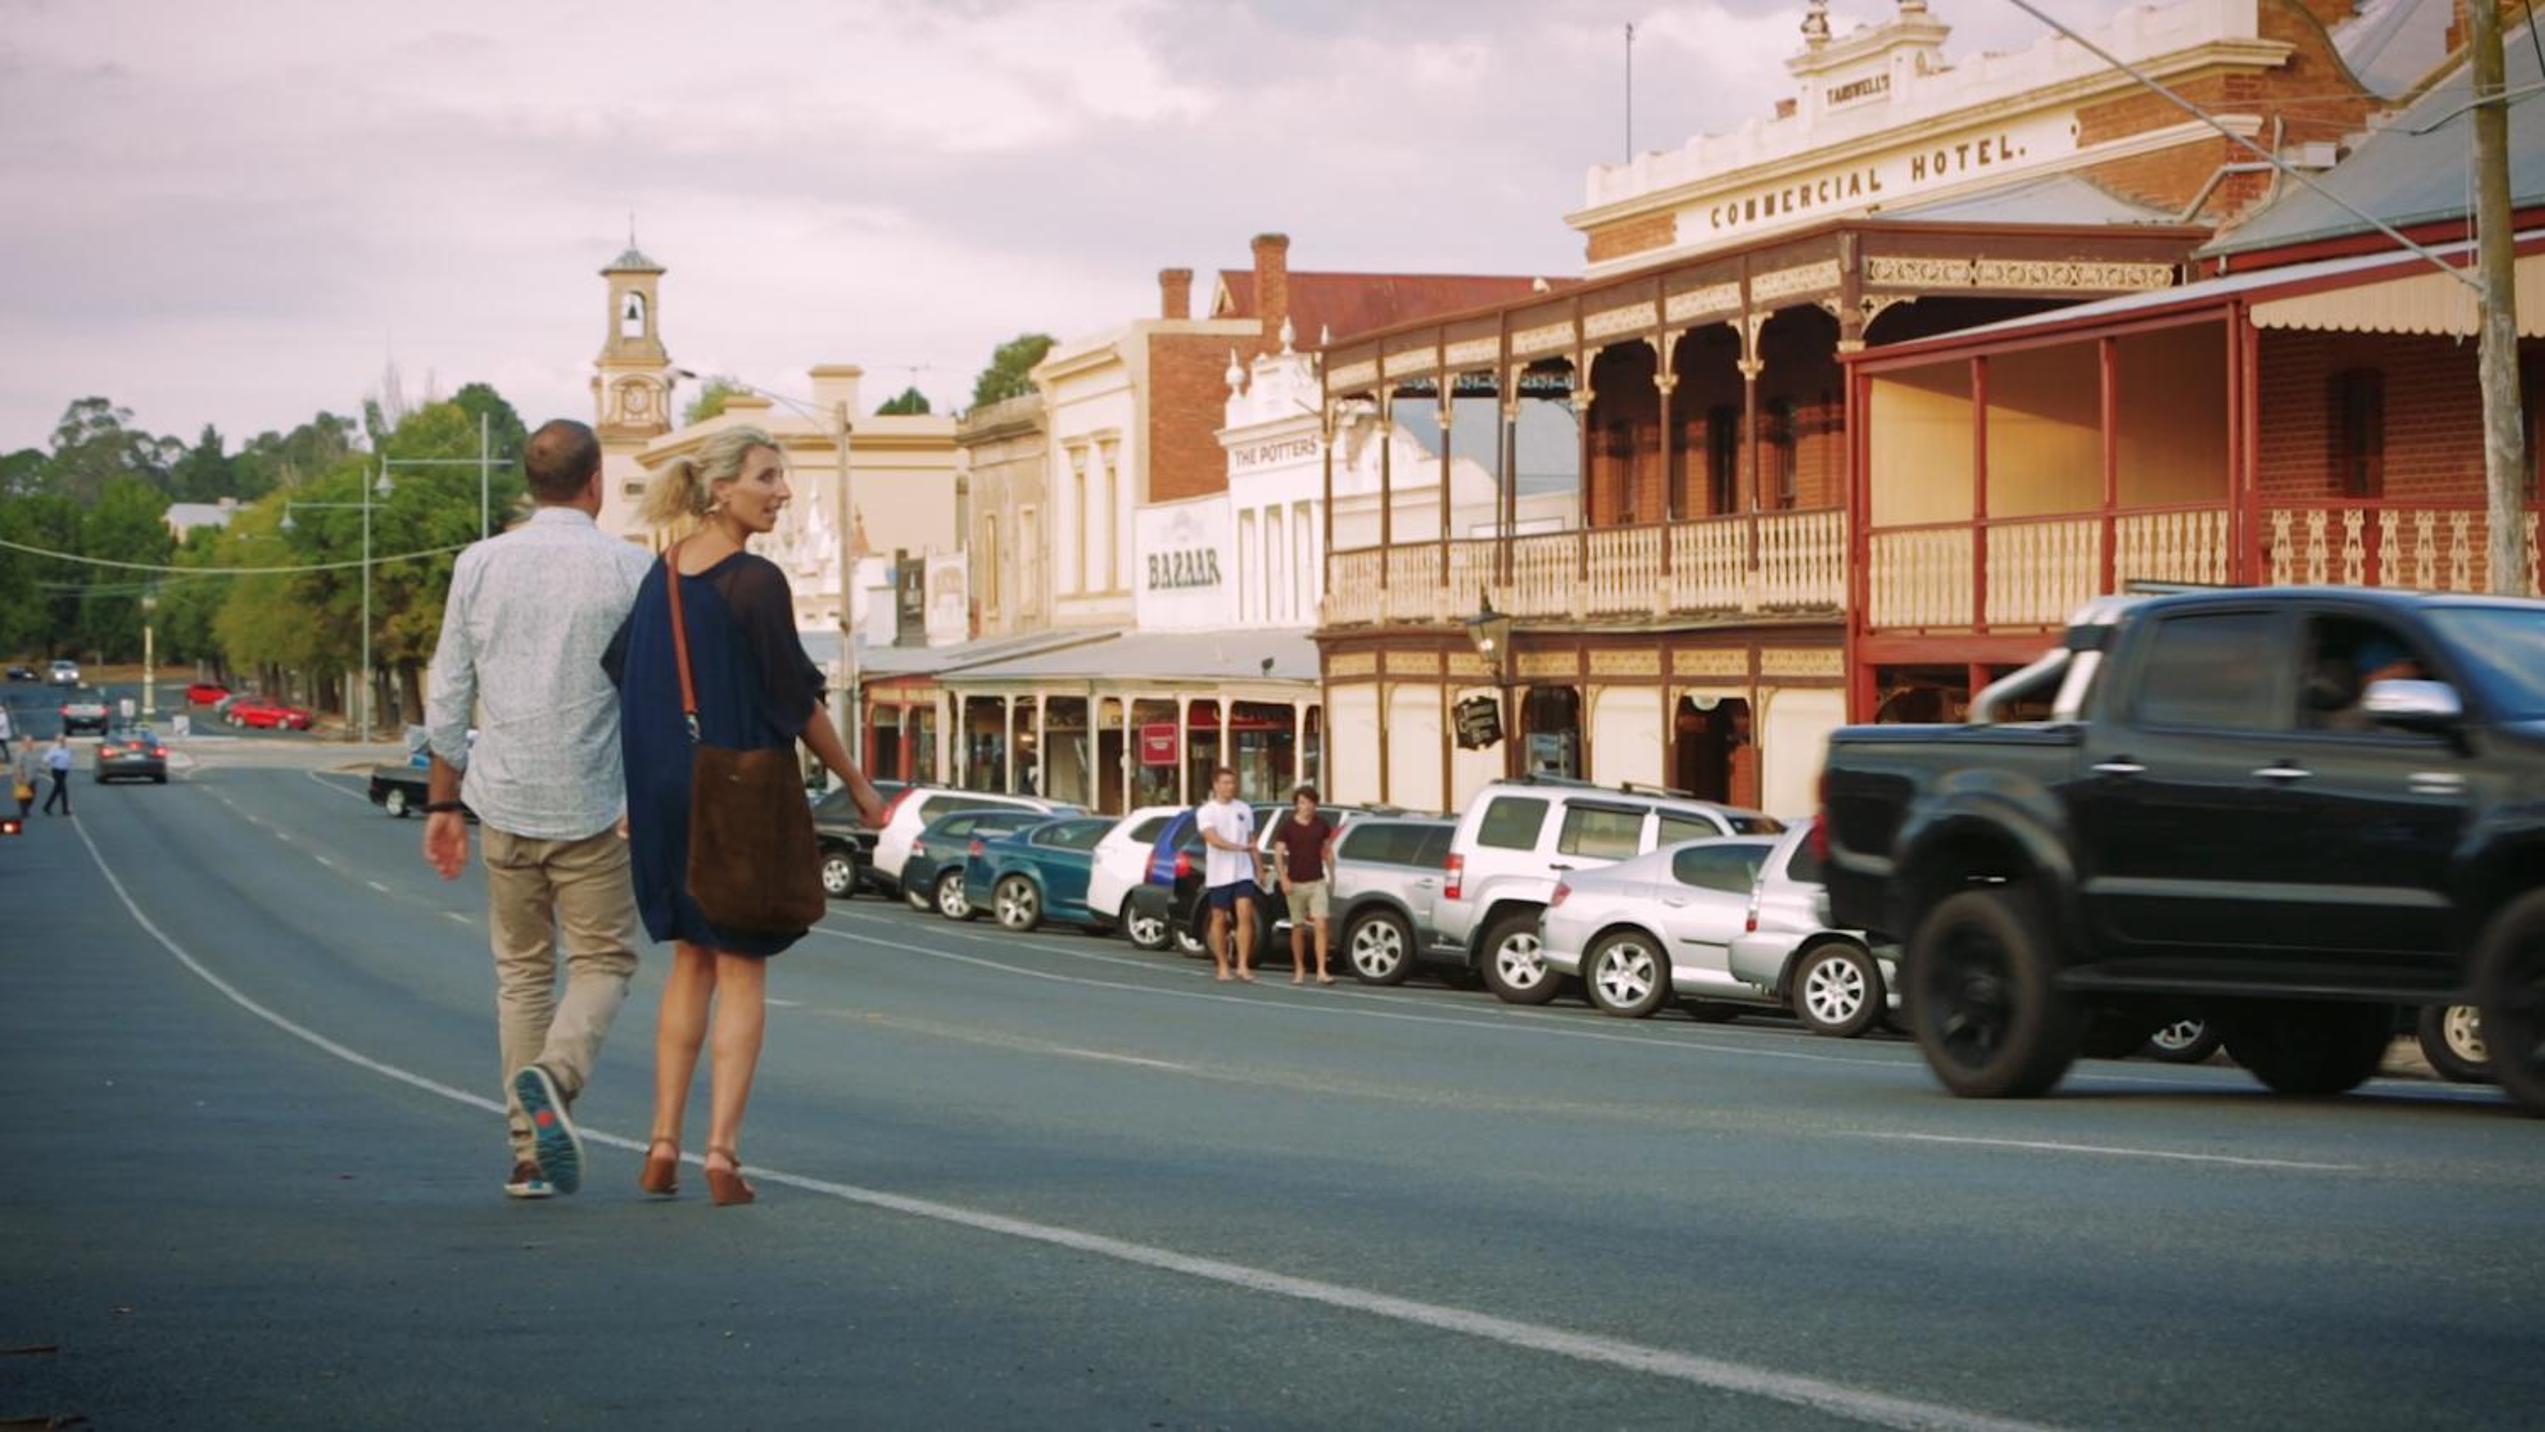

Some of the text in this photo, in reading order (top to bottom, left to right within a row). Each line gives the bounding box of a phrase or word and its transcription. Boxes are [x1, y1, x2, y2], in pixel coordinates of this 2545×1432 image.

[1711, 136, 2026, 228] COMMERCIAL HOTEL.
[1234, 435, 1317, 467] THE POTTERS
[1148, 548, 1221, 590] BAZAAR
